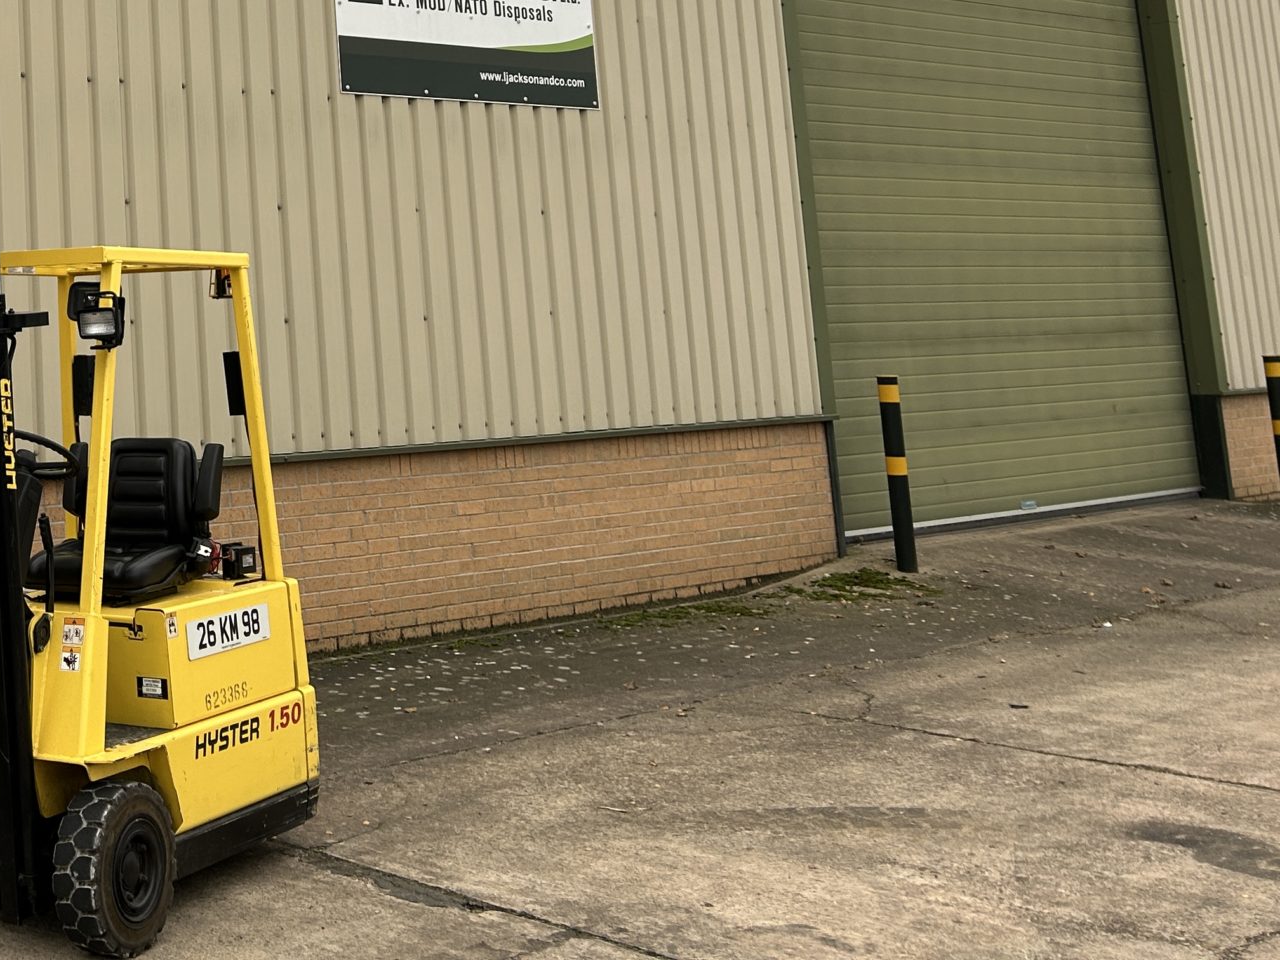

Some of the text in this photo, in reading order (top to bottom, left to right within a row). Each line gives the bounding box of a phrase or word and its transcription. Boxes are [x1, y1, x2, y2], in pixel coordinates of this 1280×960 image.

[493, 0, 554, 23] Disposals
[479, 71, 586, 88] www.ljacksonandco.com
[196, 608, 261, 651] 26 KM 98
[195, 702, 302, 760] HYSTER 1.50
